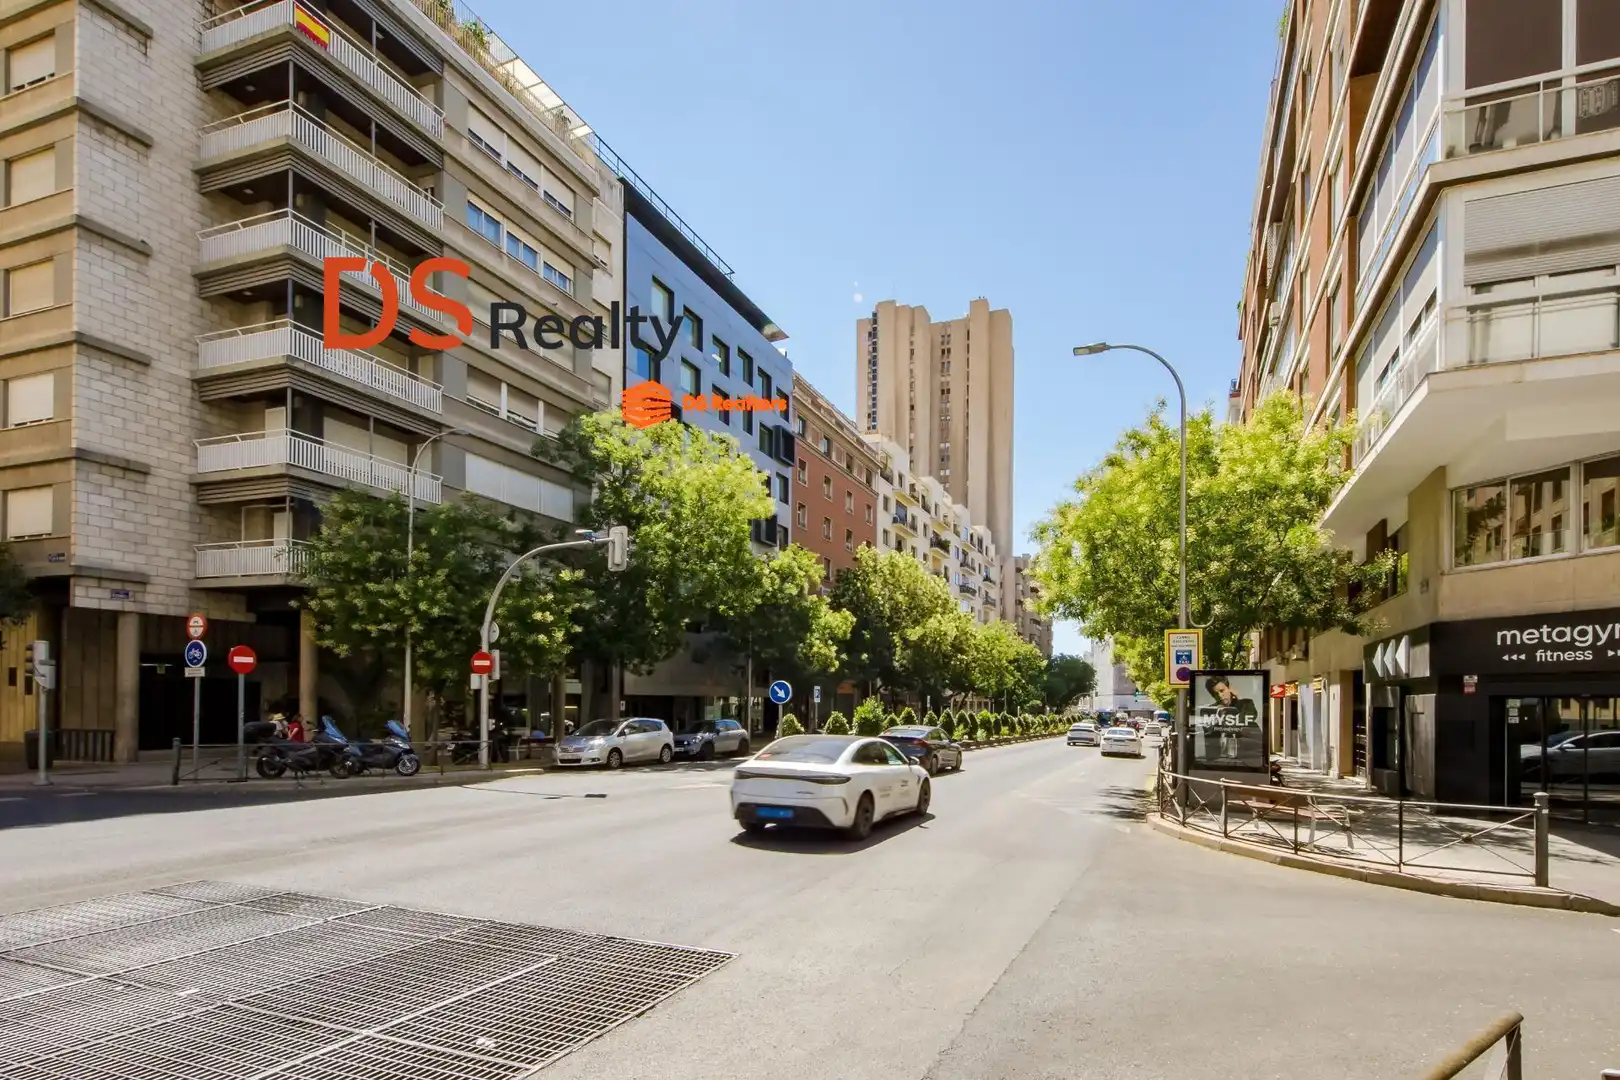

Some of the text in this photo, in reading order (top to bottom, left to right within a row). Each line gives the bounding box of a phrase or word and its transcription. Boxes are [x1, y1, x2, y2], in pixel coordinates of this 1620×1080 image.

[1496, 622, 1620, 648] metagy
[1535, 648, 1593, 662] fitness
[1203, 713, 1254, 726] MYSLF
